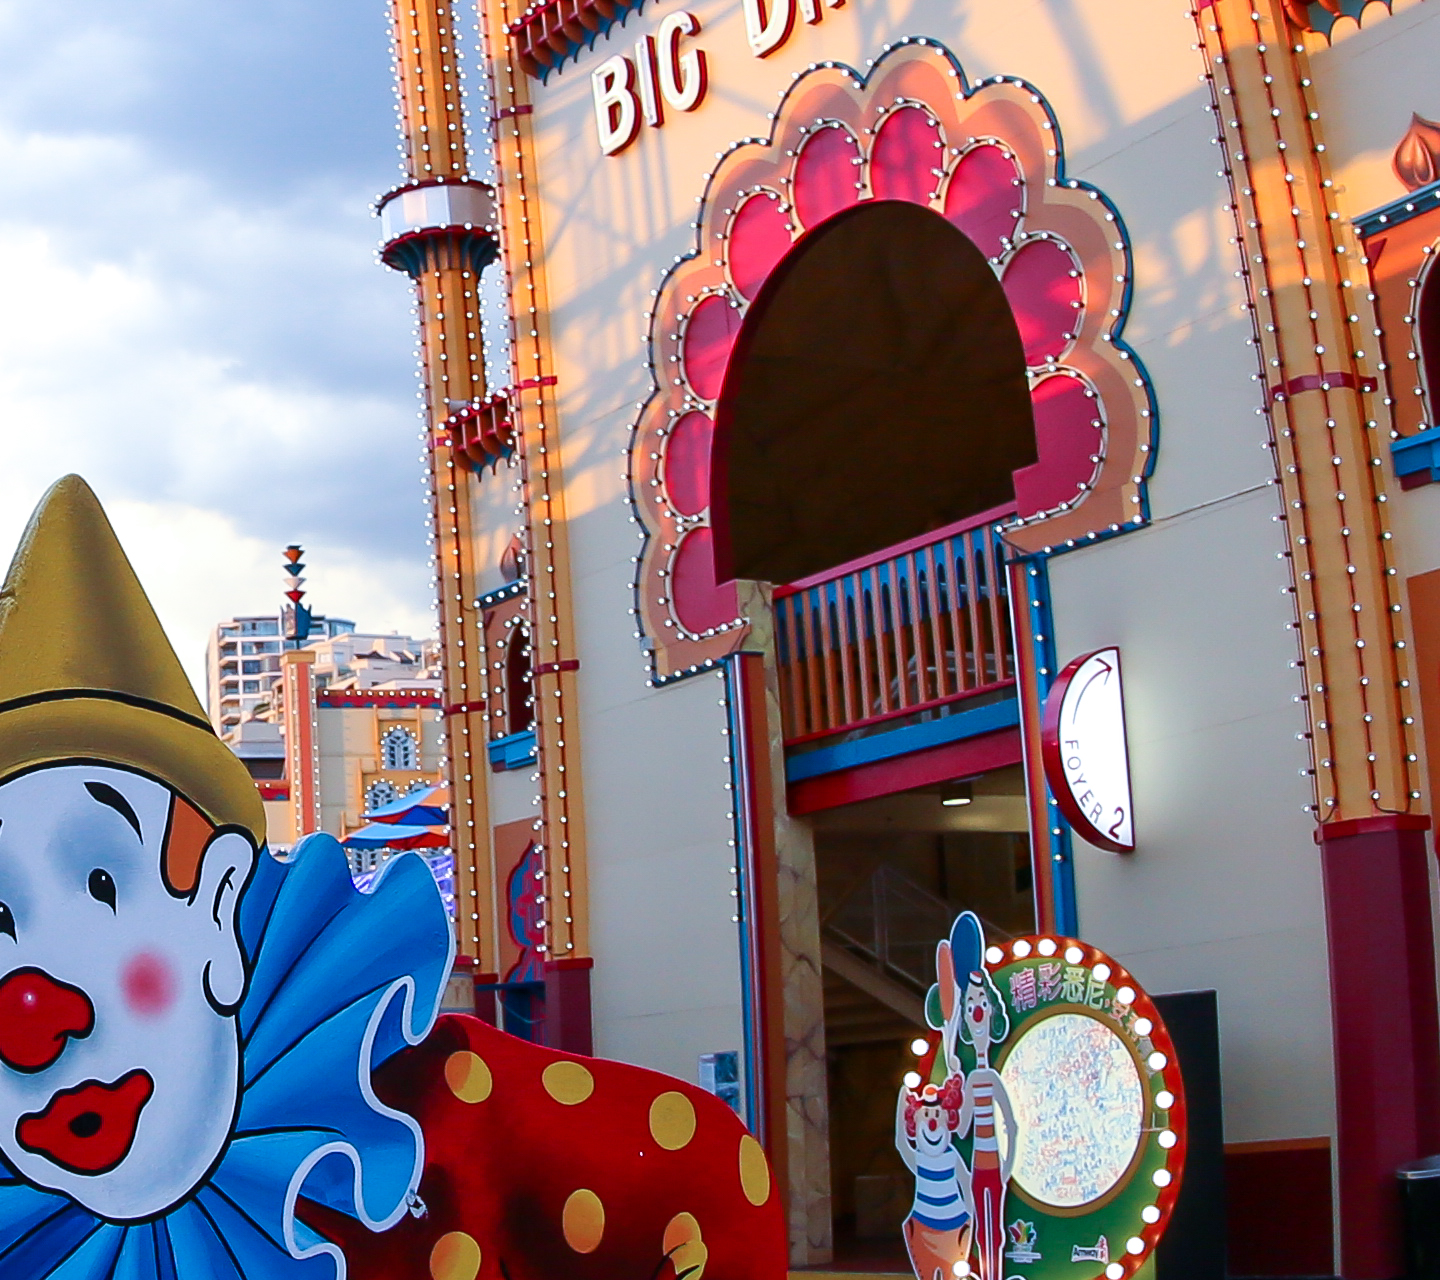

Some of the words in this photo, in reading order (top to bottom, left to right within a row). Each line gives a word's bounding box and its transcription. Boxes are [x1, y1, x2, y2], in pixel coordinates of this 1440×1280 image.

[590, 9, 709, 157] BIG
[1064, 739, 1104, 825] FOYER
[1108, 806, 1125, 840] 2
